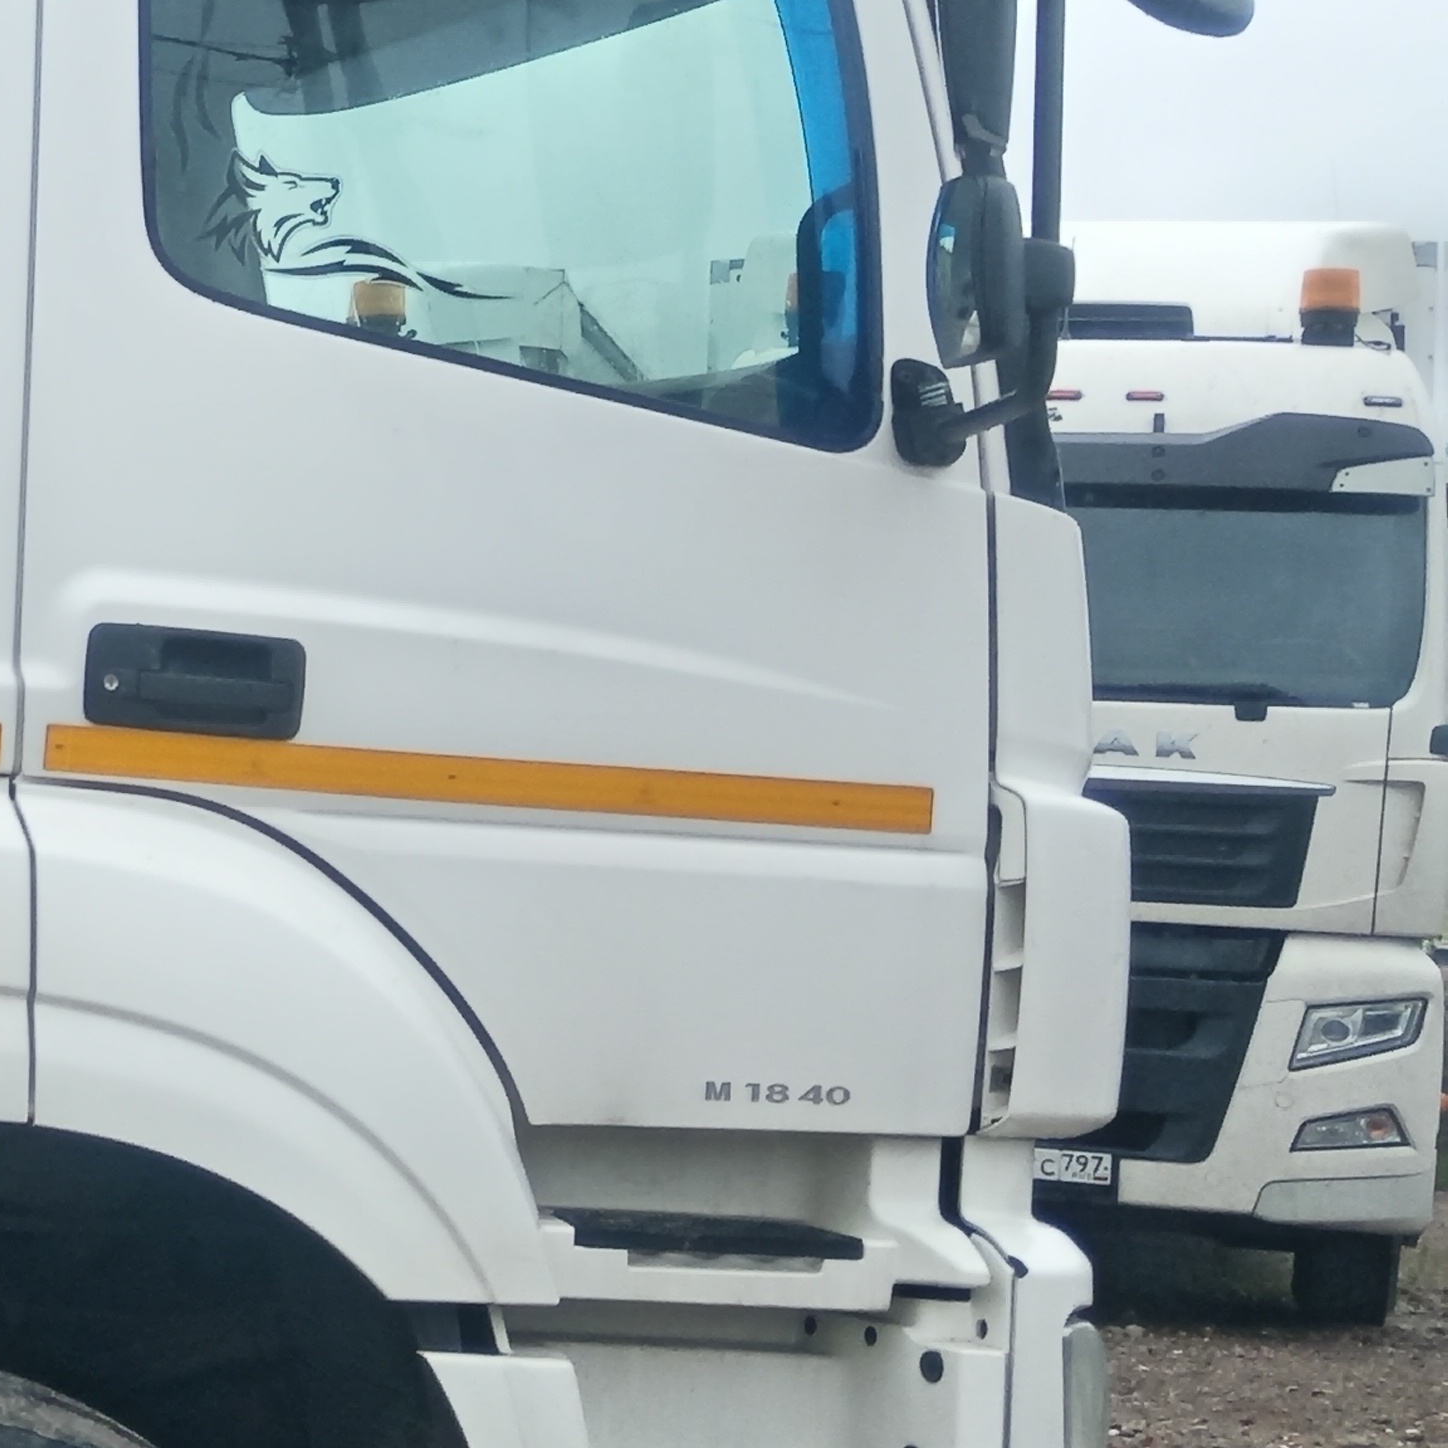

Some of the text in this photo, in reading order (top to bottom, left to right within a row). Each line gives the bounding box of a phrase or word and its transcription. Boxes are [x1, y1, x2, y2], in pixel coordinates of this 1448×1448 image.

[704, 1080, 851, 1106] M 1840
[1061, 1153, 1104, 1176] 797
